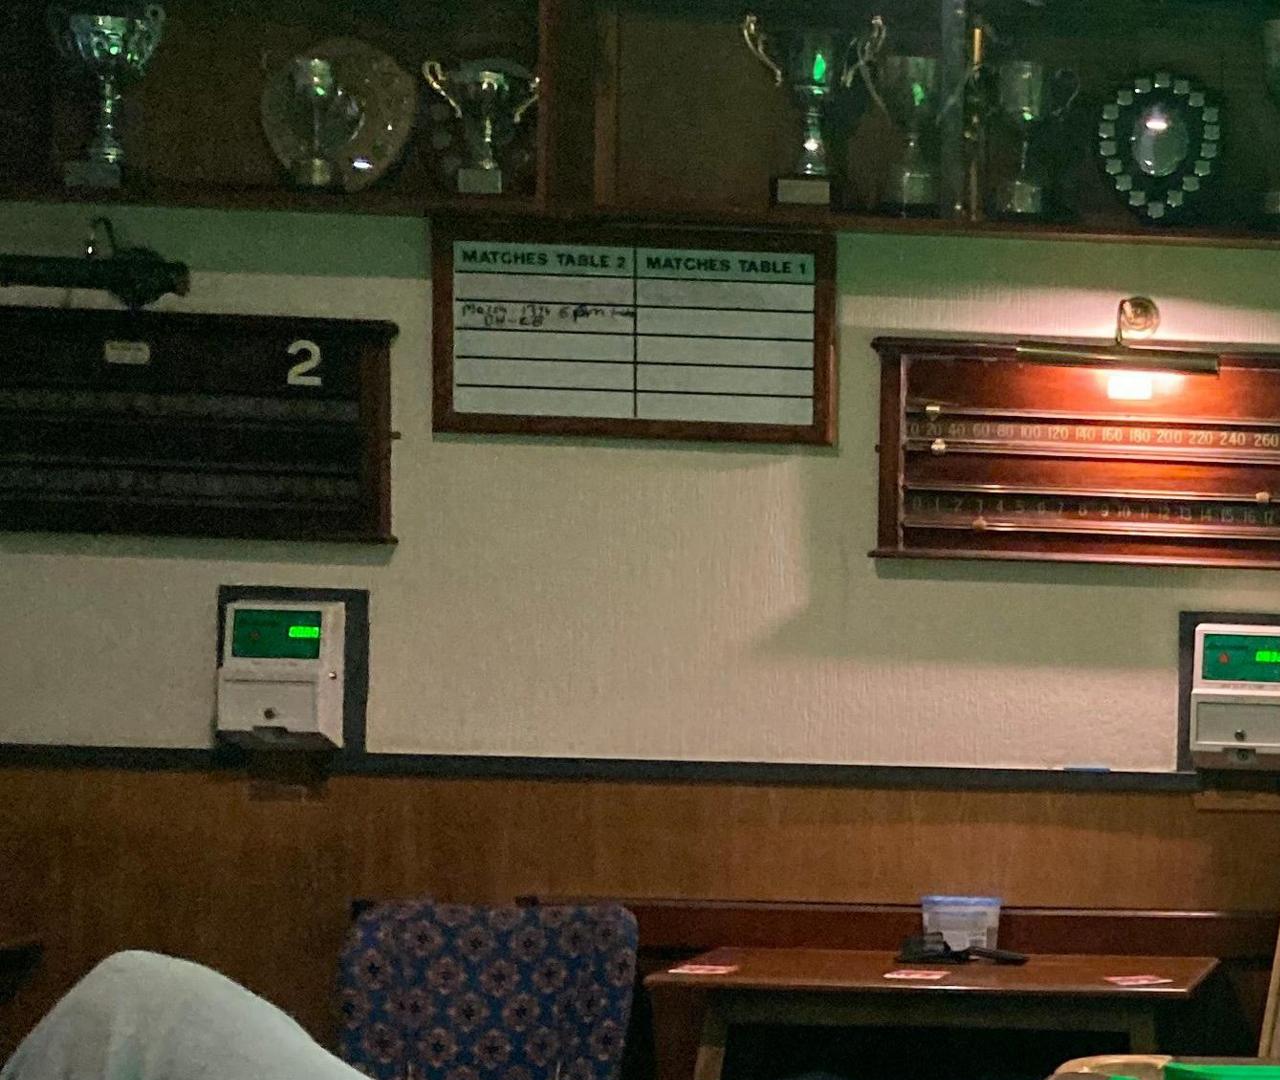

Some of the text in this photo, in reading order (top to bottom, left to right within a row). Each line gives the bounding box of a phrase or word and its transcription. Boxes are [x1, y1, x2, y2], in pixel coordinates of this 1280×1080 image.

[461, 250, 626, 269] MATCHES TABLE 2
[646, 256, 806, 275] MATCHES TABLE 1
[286, 339, 323, 386] 2
[926, 423, 942, 436] 20
[1020, 425, 1041, 438] 100
[1048, 426, 1069, 440] 120
[1075, 426, 1096, 440] 140
[1102, 427, 1123, 441] 160
[1129, 429, 1149, 443] 180
[1157, 429, 1183, 444] 200
[1188, 430, 1213, 445] 220
[1219, 431, 1246, 446] 240
[1254, 433, 1279, 448] 260
